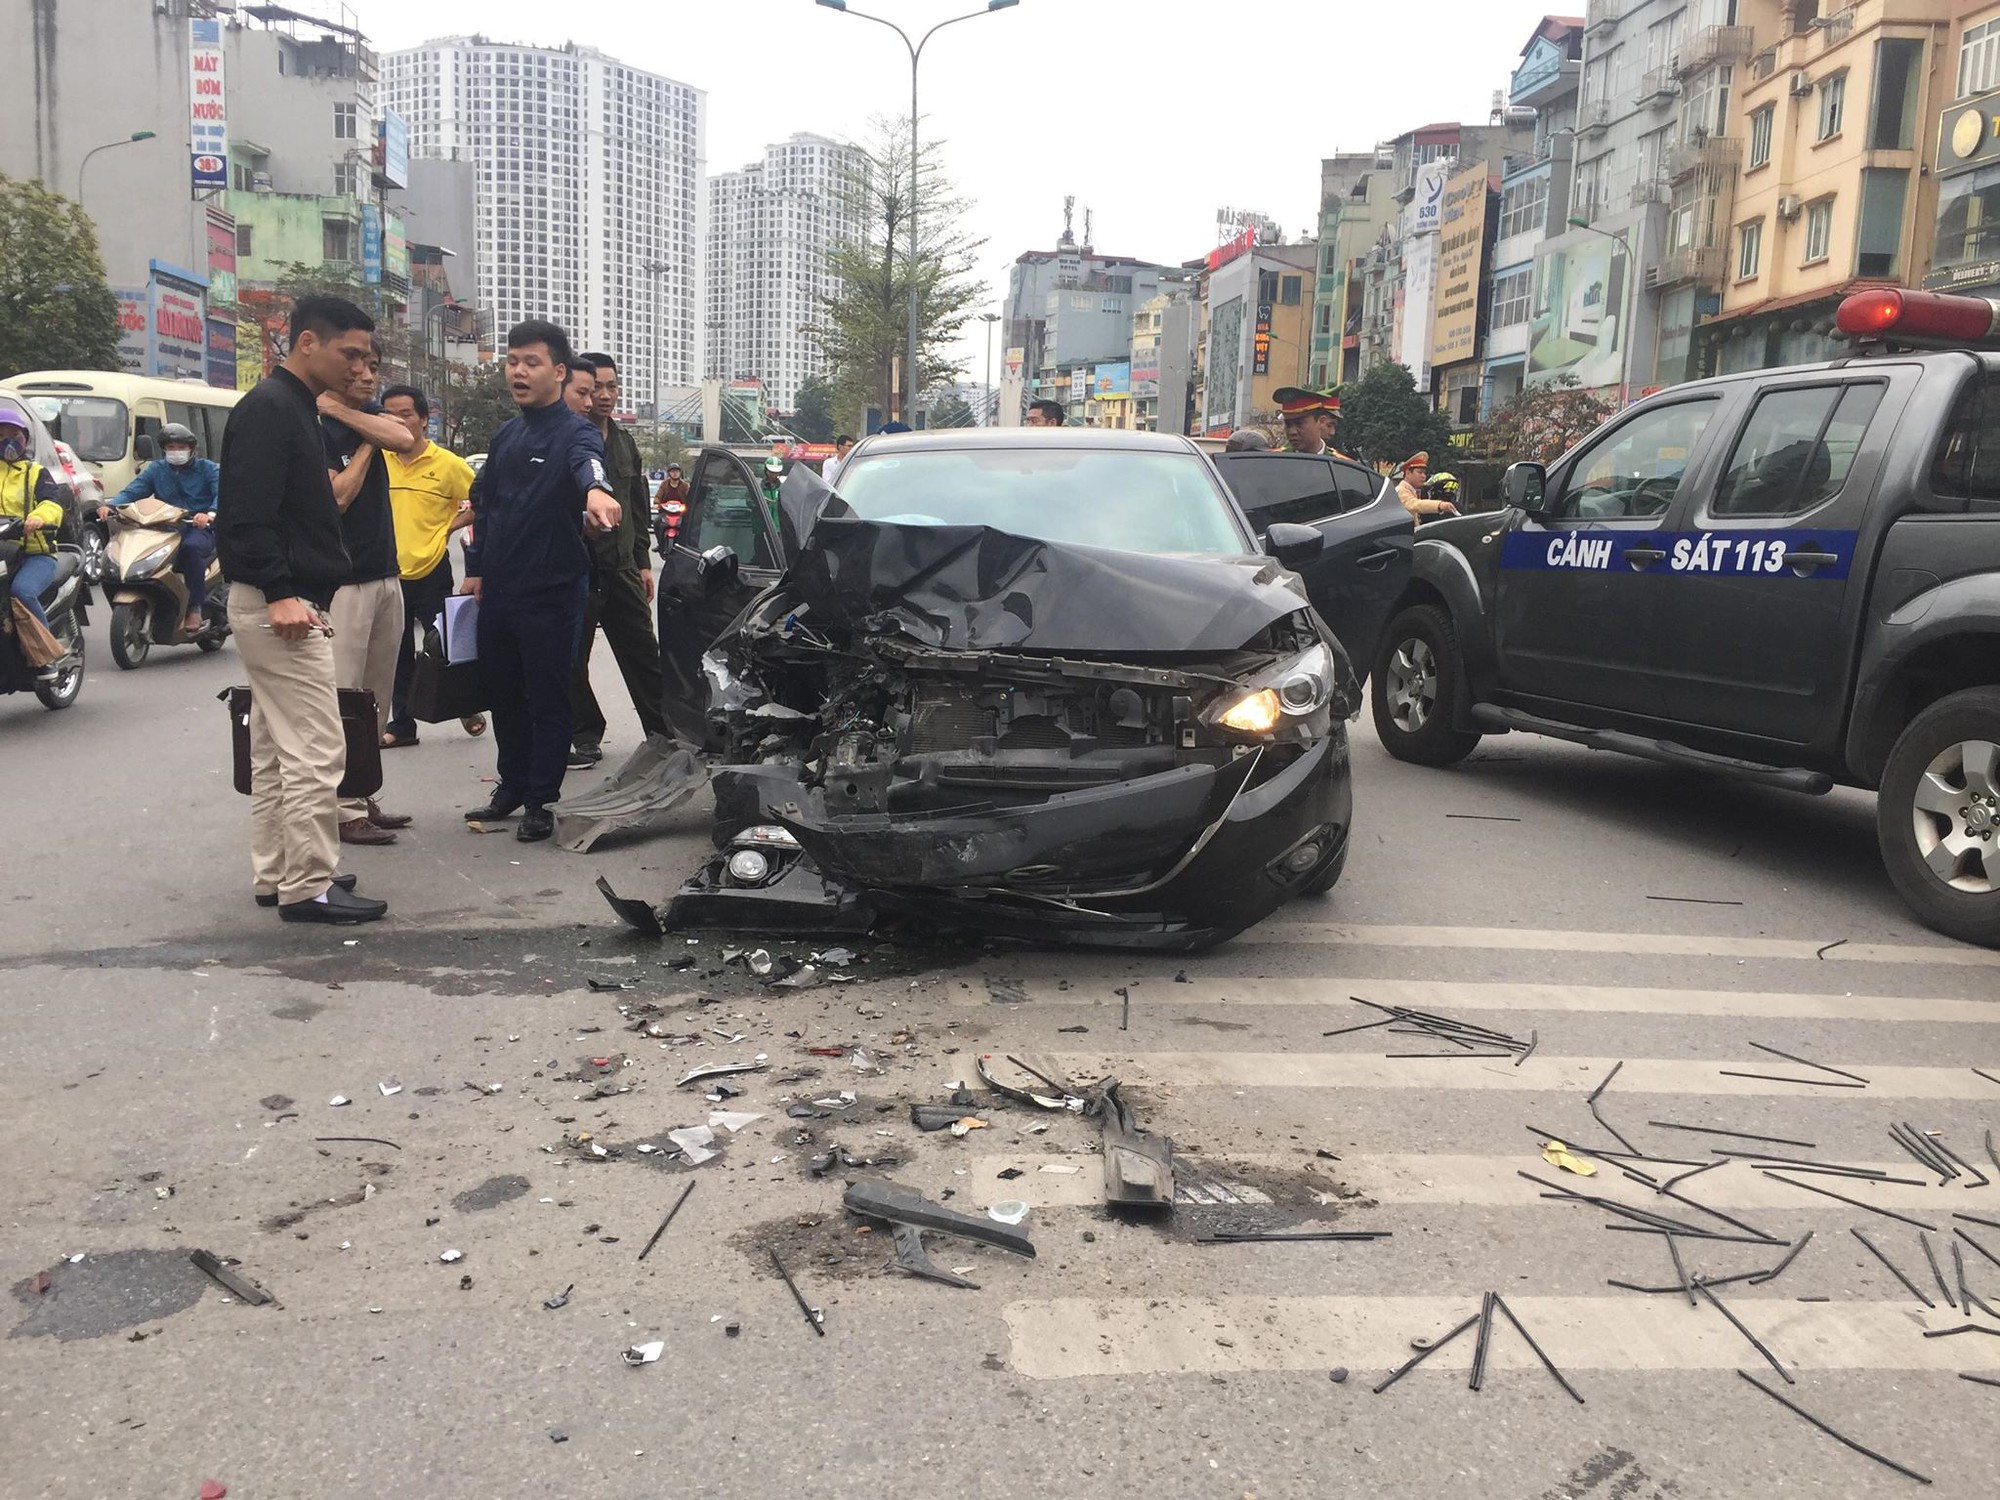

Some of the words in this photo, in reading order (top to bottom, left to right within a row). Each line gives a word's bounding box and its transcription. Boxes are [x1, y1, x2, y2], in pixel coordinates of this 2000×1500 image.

[194, 52, 218, 72] MÁY
[196, 78, 221, 95] BƠM
[193, 99, 223, 119] NƯỚC
[1419, 205, 1437, 219] 630
[1546, 530, 1612, 569] CẢNH
[1670, 532, 1731, 571] SÁT
[1735, 540, 1787, 572] 113
